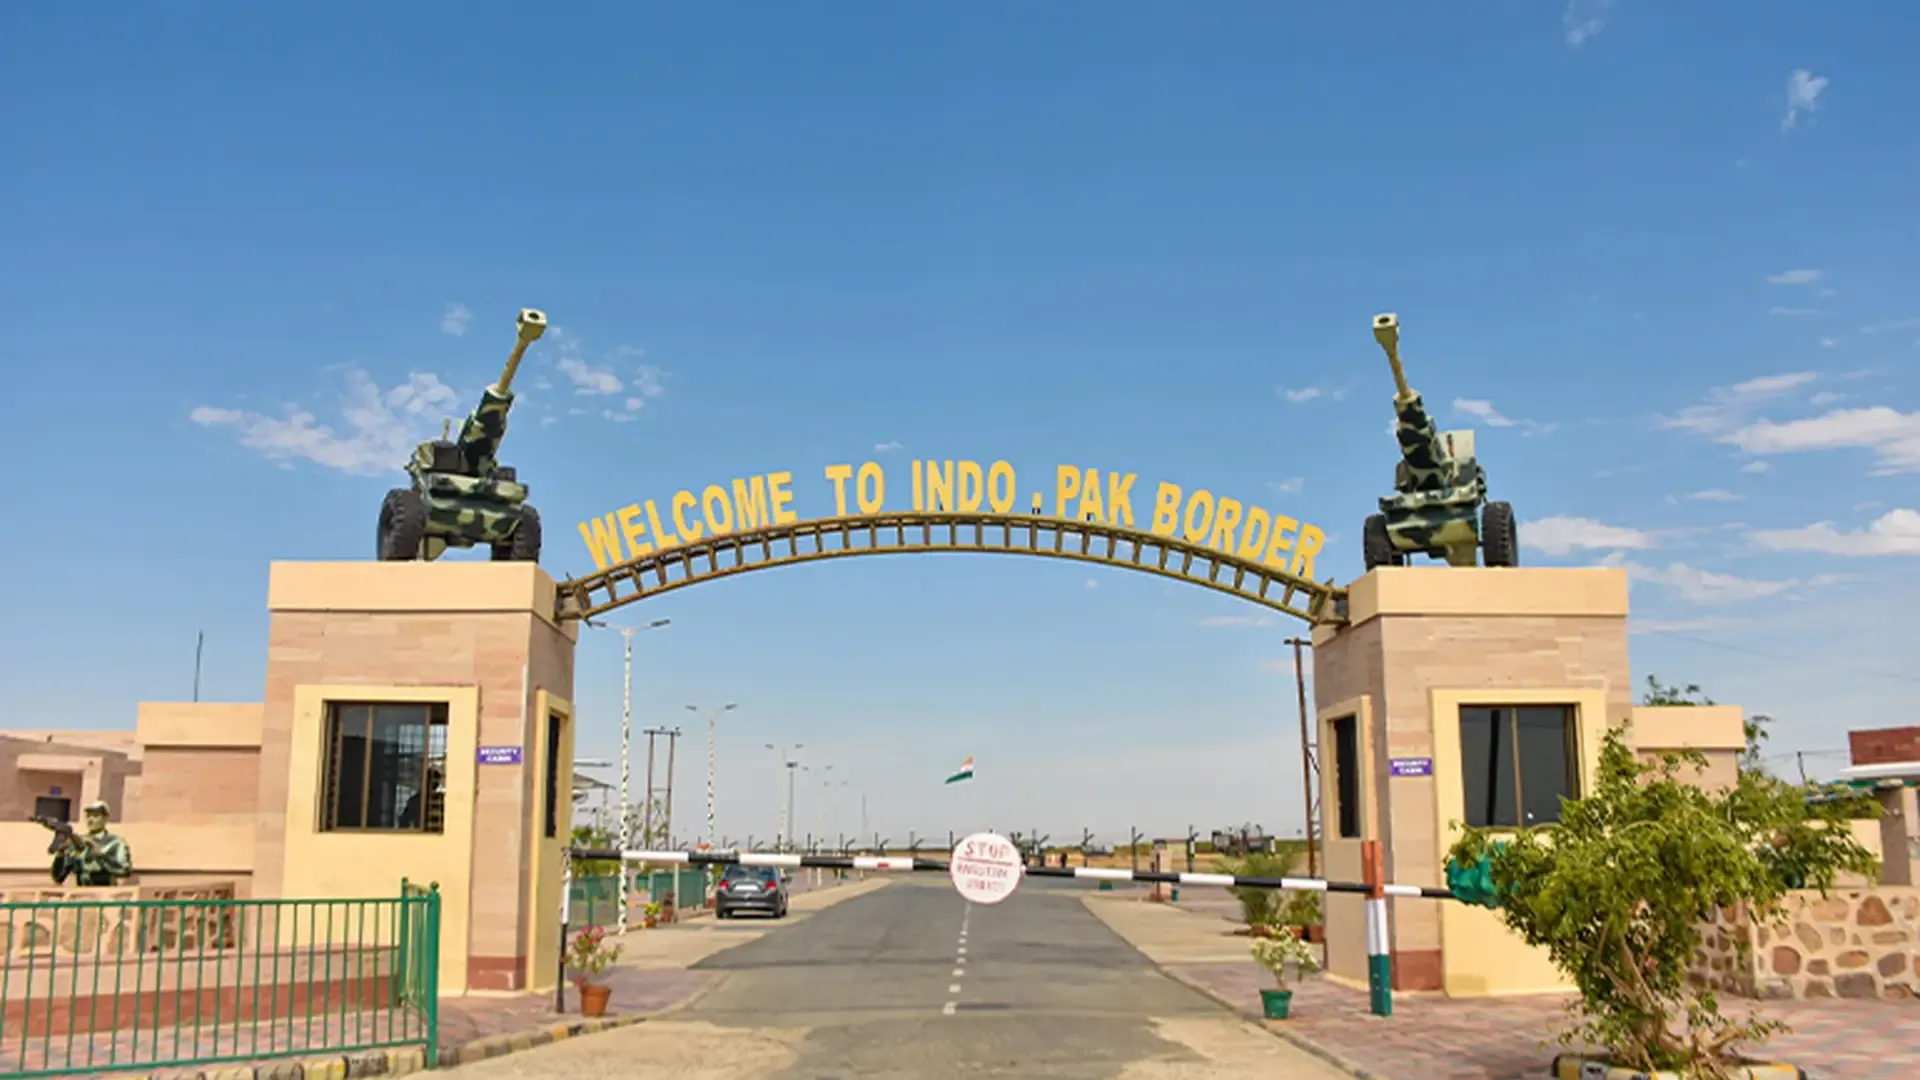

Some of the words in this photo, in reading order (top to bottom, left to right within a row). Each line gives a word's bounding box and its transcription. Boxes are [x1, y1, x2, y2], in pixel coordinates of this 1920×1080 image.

[578, 471, 798, 571] WELCOME
[825, 461, 885, 517] TO
[911, 459, 1016, 514] INDO
[1056, 464, 1138, 528] PAK
[1152, 481, 1326, 580] BORDER
[964, 840, 1010, 859] STOP
